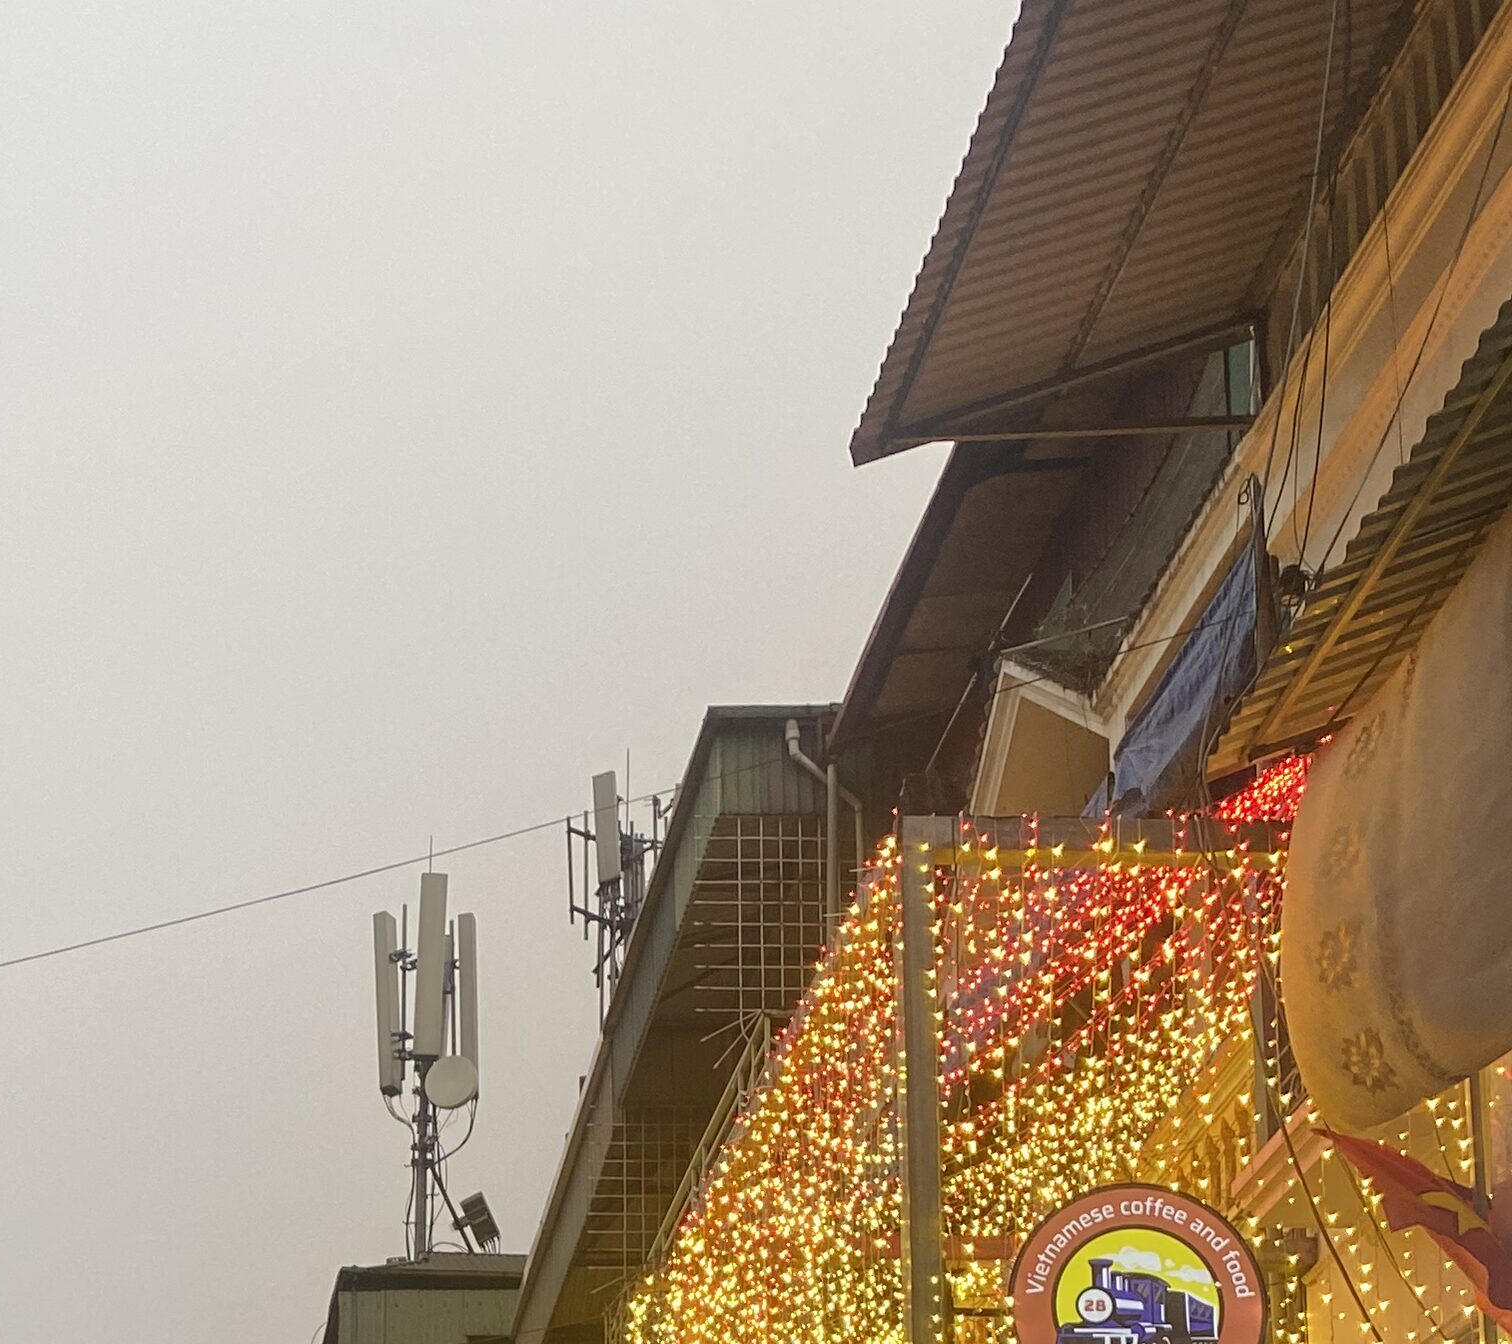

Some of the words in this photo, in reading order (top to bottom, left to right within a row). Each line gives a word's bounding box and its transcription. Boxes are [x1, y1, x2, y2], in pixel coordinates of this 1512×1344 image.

[1025, 1202, 1115, 1295] Vietnamese
[1120, 1197, 1188, 1225] coffee
[1189, 1220, 1230, 1252] and
[1221, 1249, 1256, 1298] food
[1084, 1299, 1106, 1312] 28
